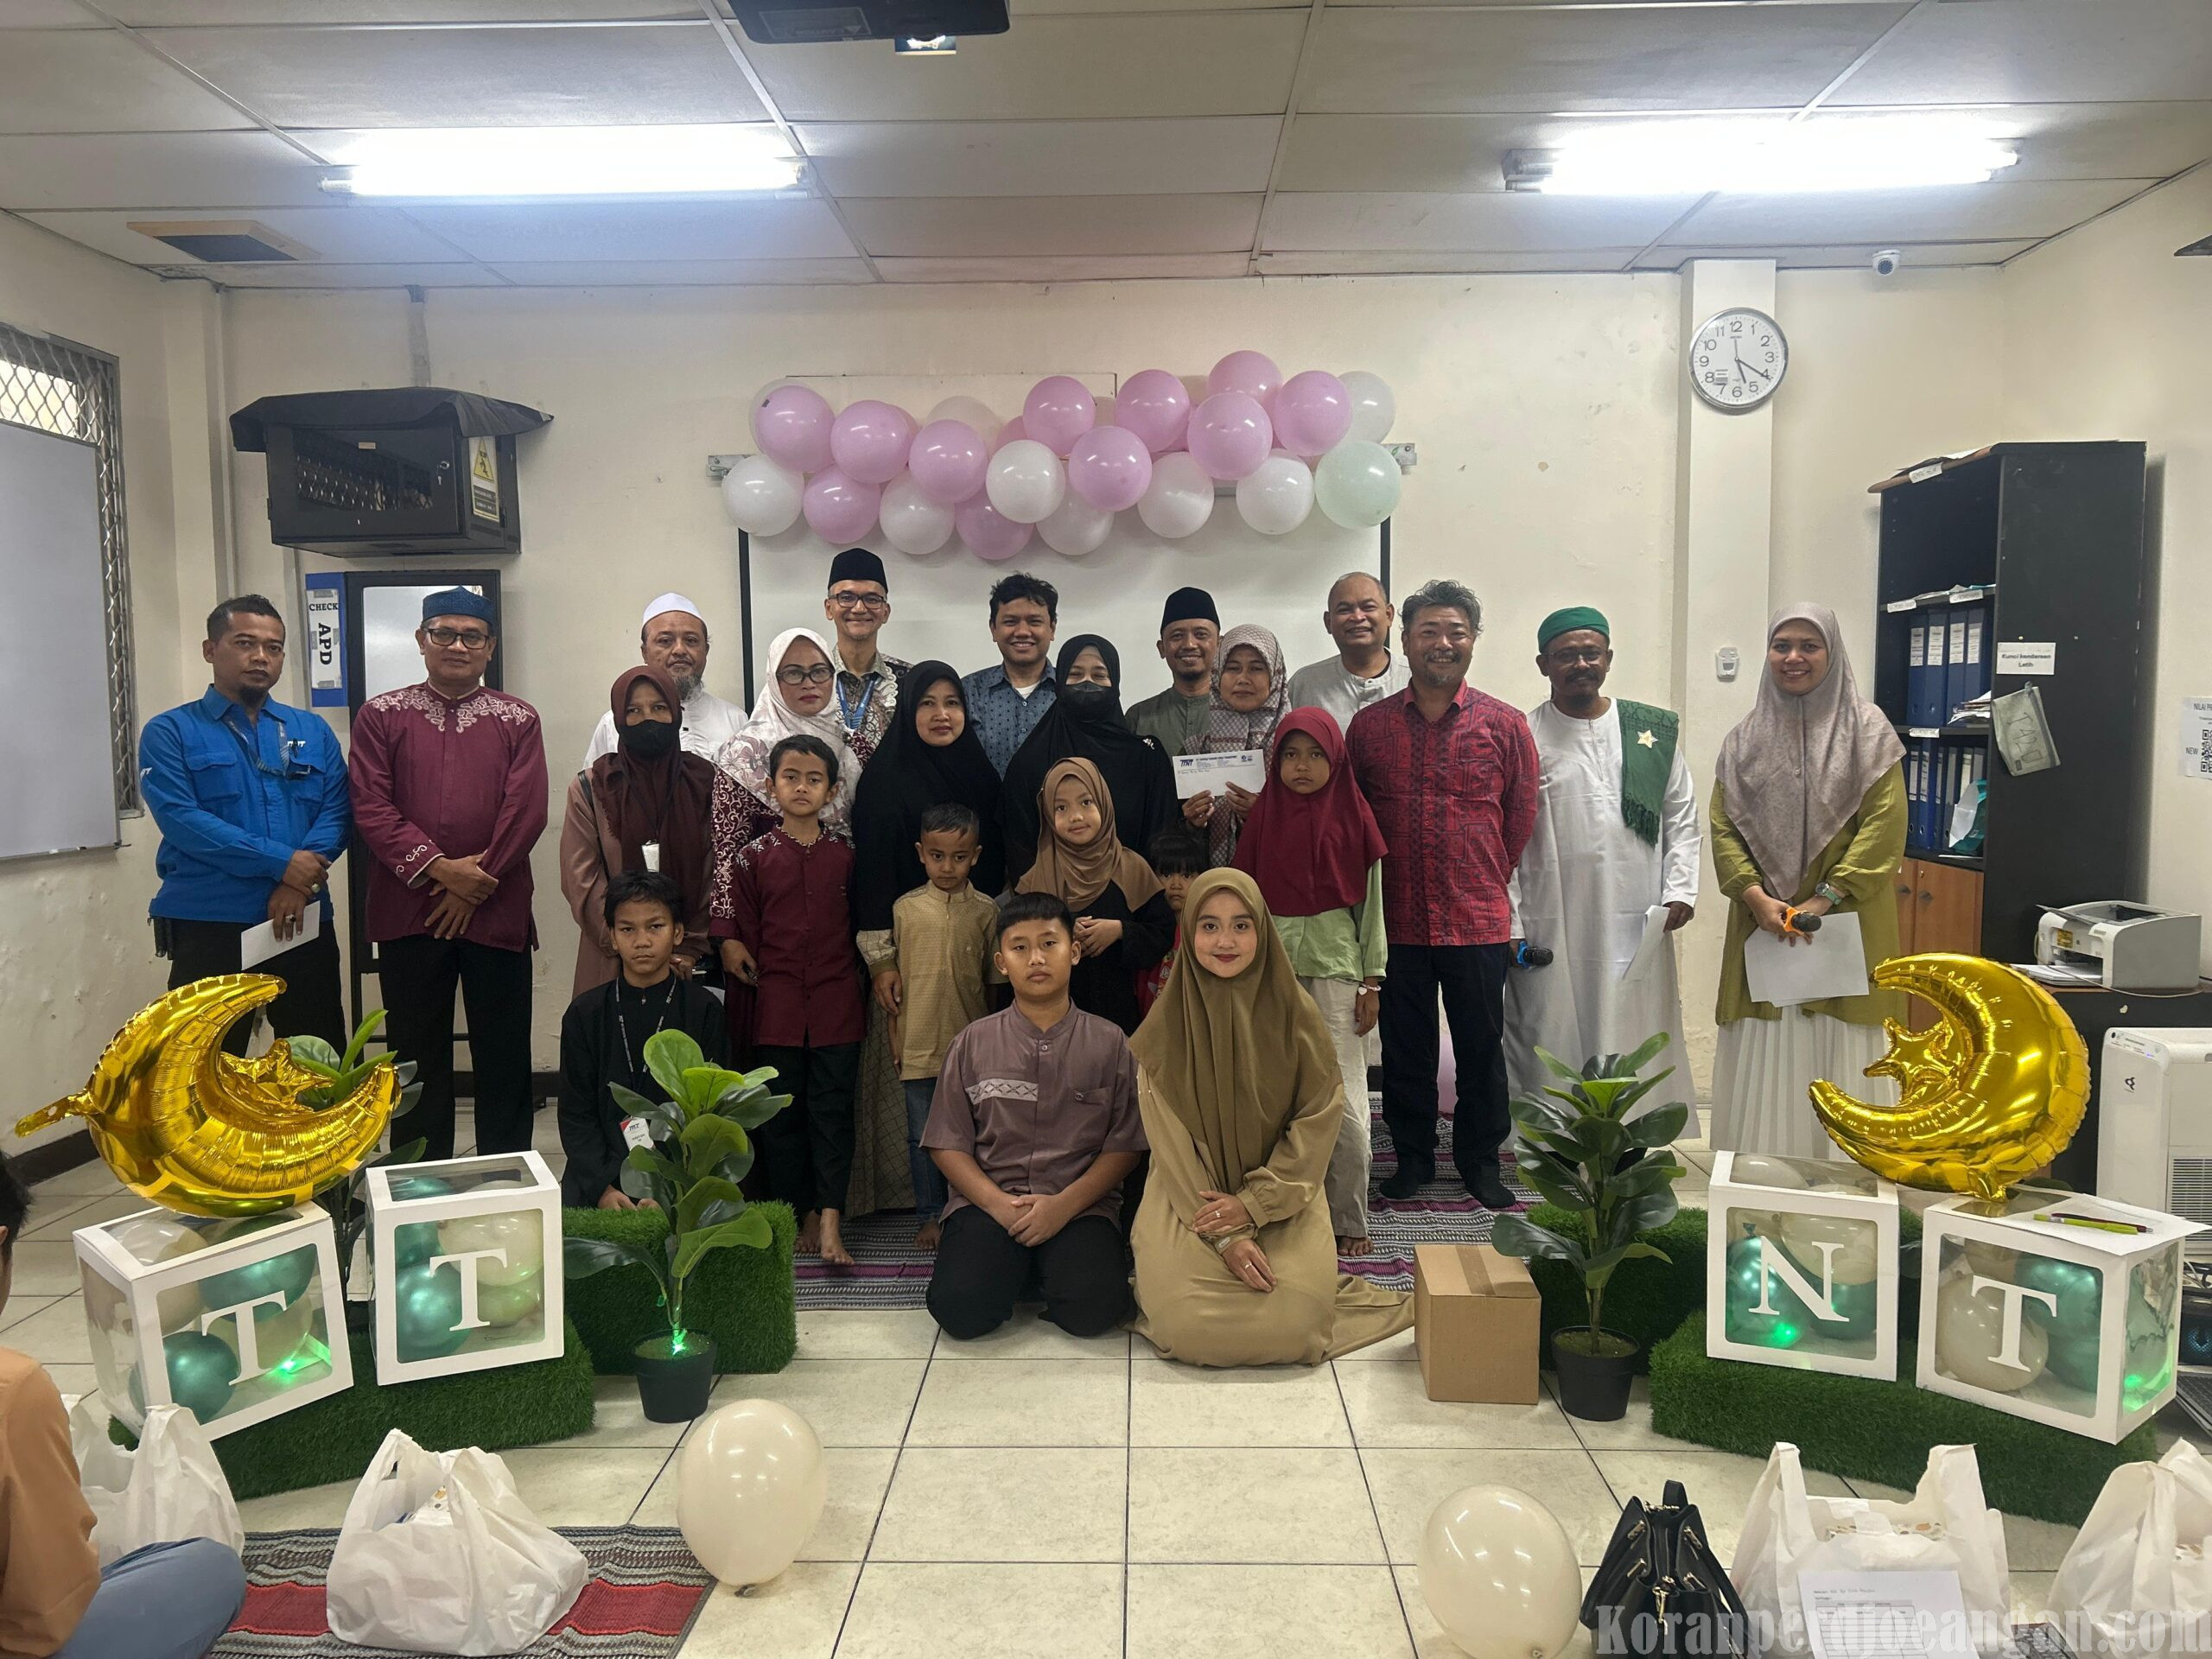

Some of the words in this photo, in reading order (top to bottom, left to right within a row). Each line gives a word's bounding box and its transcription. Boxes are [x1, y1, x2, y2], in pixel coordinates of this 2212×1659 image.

[1715, 326, 1725, 337] 11
[1730, 321, 1742, 333] 12
[1751, 324, 1755, 335] 1
[1704, 339, 1717, 351] 10
[1760, 335, 1770, 346] 2
[1699, 355, 1709, 367] 9
[1764, 352, 1775, 363] 3
[1705, 372, 1714, 383] 8
[1762, 368, 1770, 380] 4
[1717, 383, 1727, 395] 7
[1732, 386, 1742, 397] 6
[1749, 381, 1758, 392] 5
[308, 603, 339, 612] CHECK
[318, 622, 333, 665] APD
[2185, 747, 2199, 755] NEW
[1748, 1236, 1850, 1322] N
[1971, 1274, 2057, 1372] T
[200, 1290, 288, 1386] T
[429, 1249, 508, 1332] T
